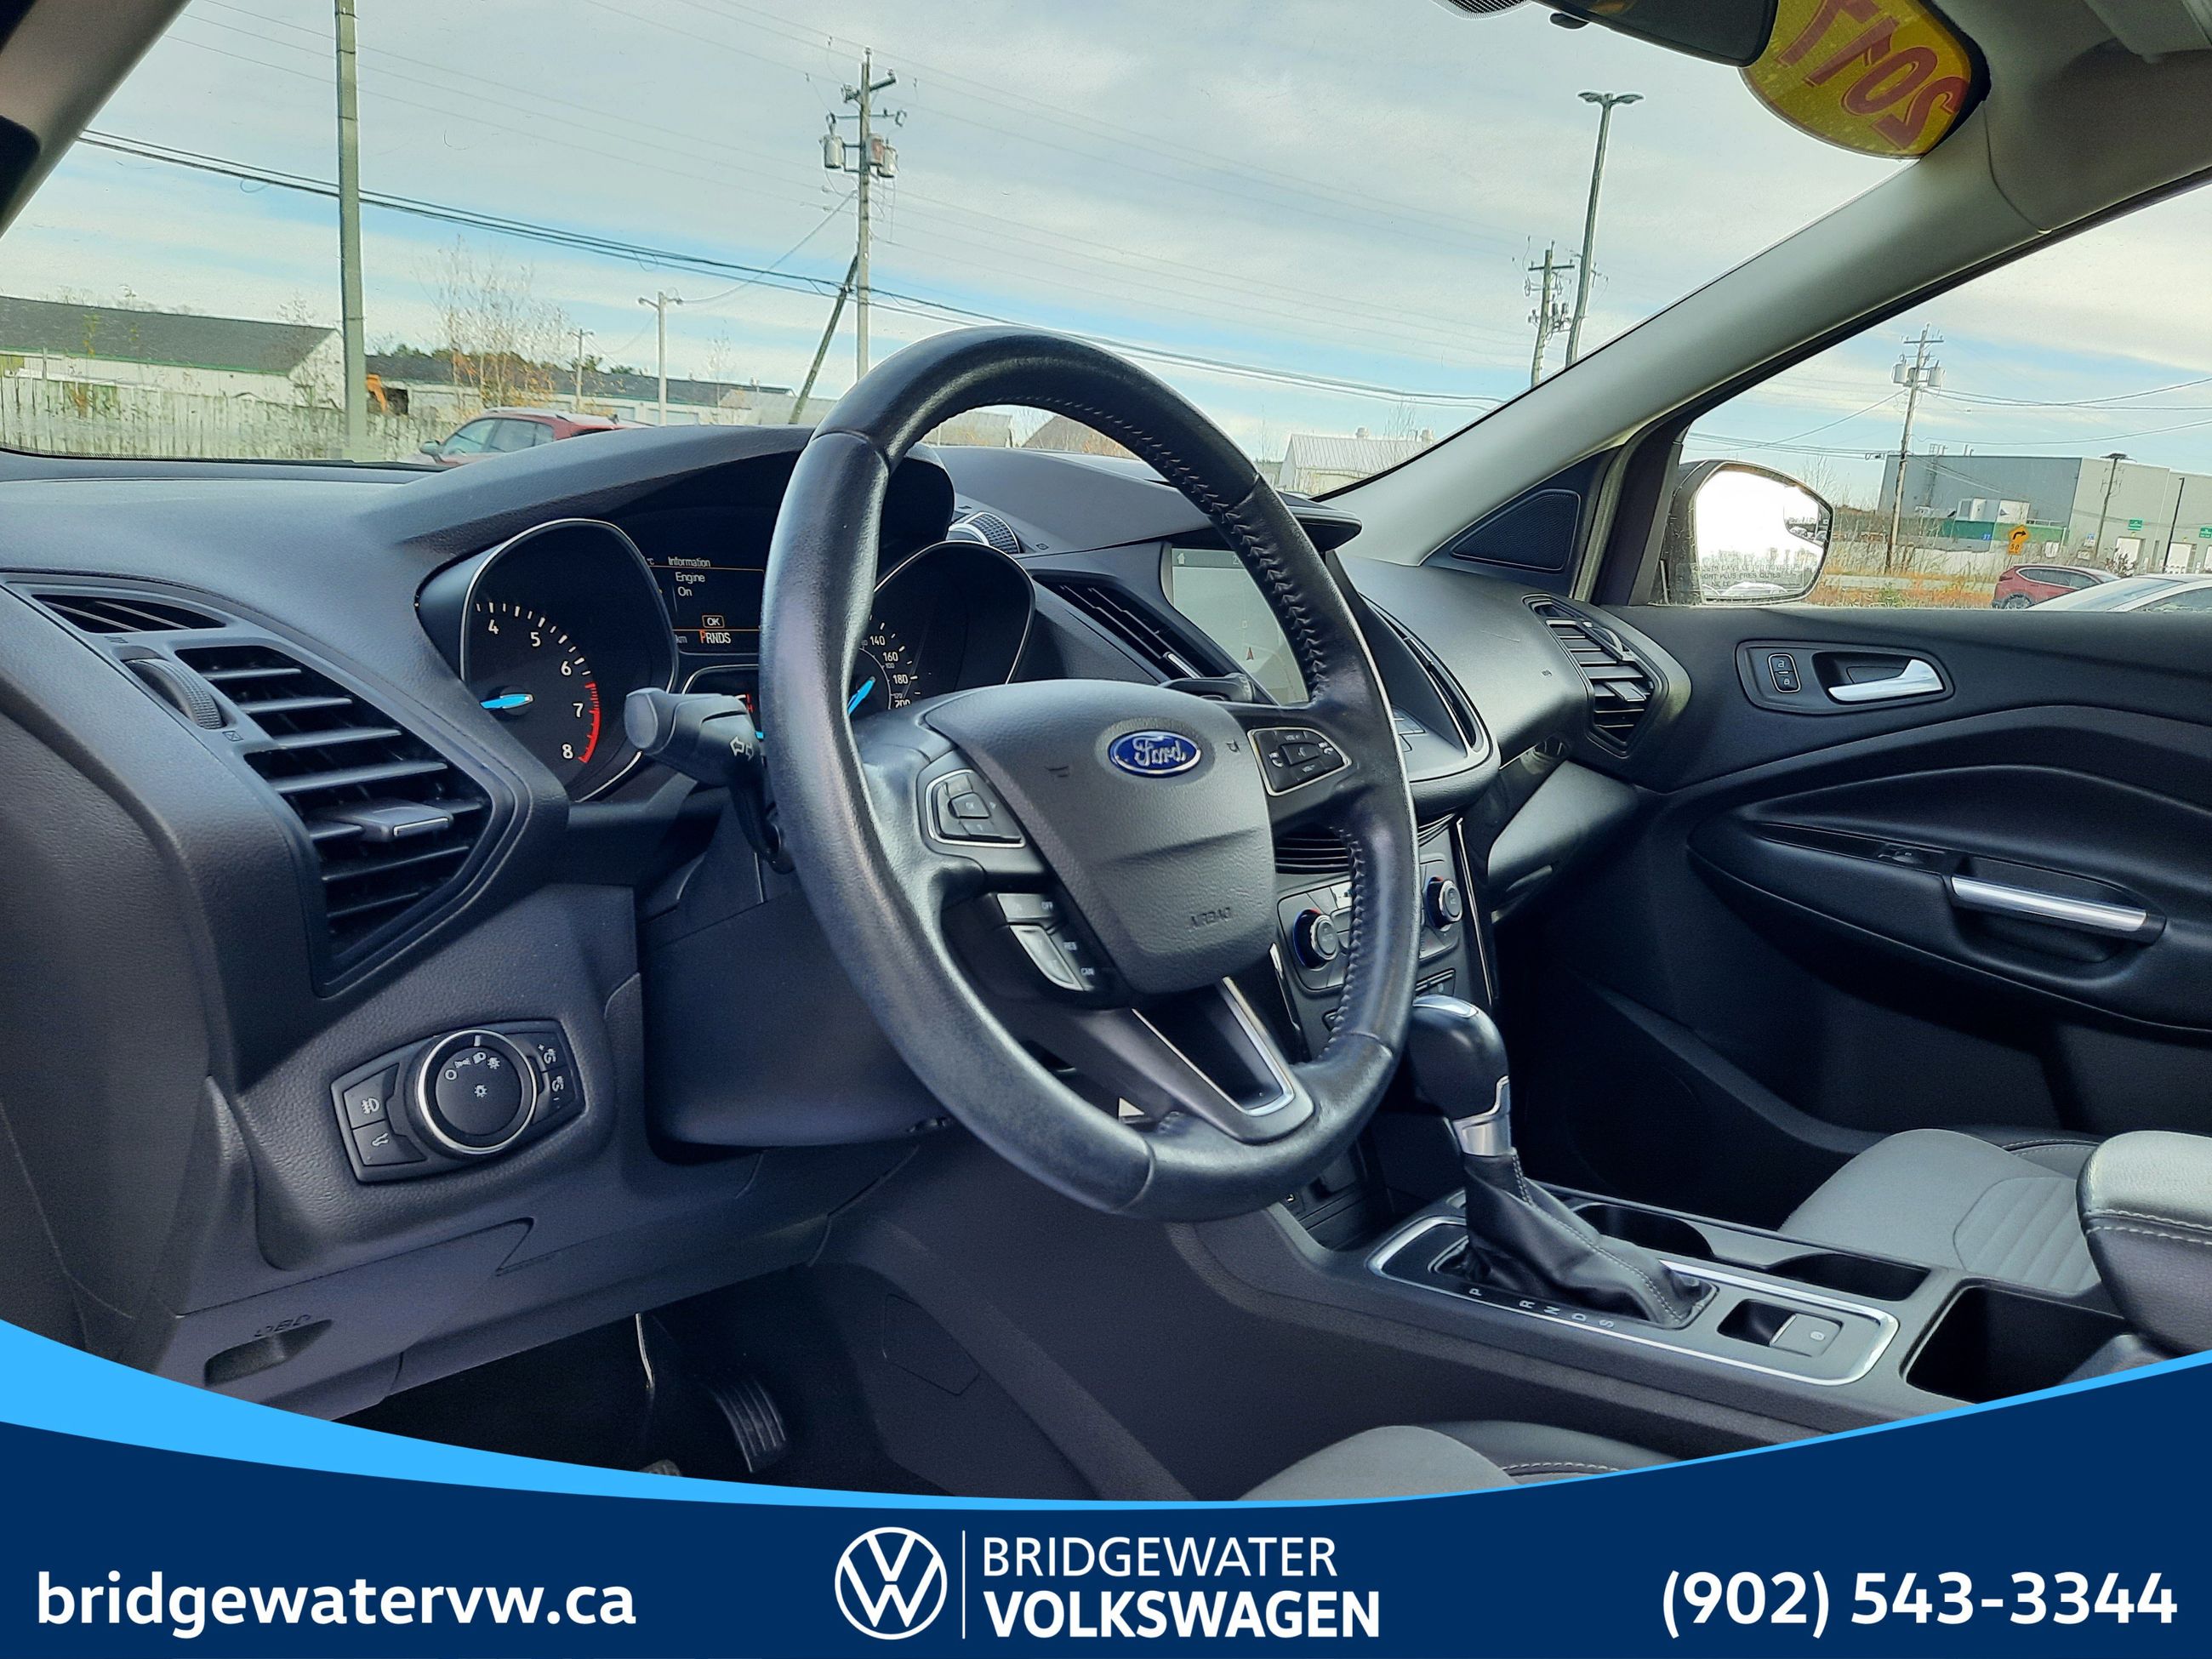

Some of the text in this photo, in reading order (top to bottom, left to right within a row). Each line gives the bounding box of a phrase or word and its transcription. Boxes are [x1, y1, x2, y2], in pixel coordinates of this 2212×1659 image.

[668, 556, 710, 567] Information
[675, 572, 705, 584] Engine
[677, 586, 693, 596] On
[487, 619, 499, 634] 4
[531, 631, 541, 647] 5
[699, 630, 731, 644] PRNDS
[869, 636, 885, 645] 140
[882, 652, 898, 662] 160
[561, 660, 572, 676] 6
[892, 675, 908, 684] 180
[573, 703, 584, 718] 7
[562, 744, 573, 760] 8
[1132, 736, 1187, 767] Ford
